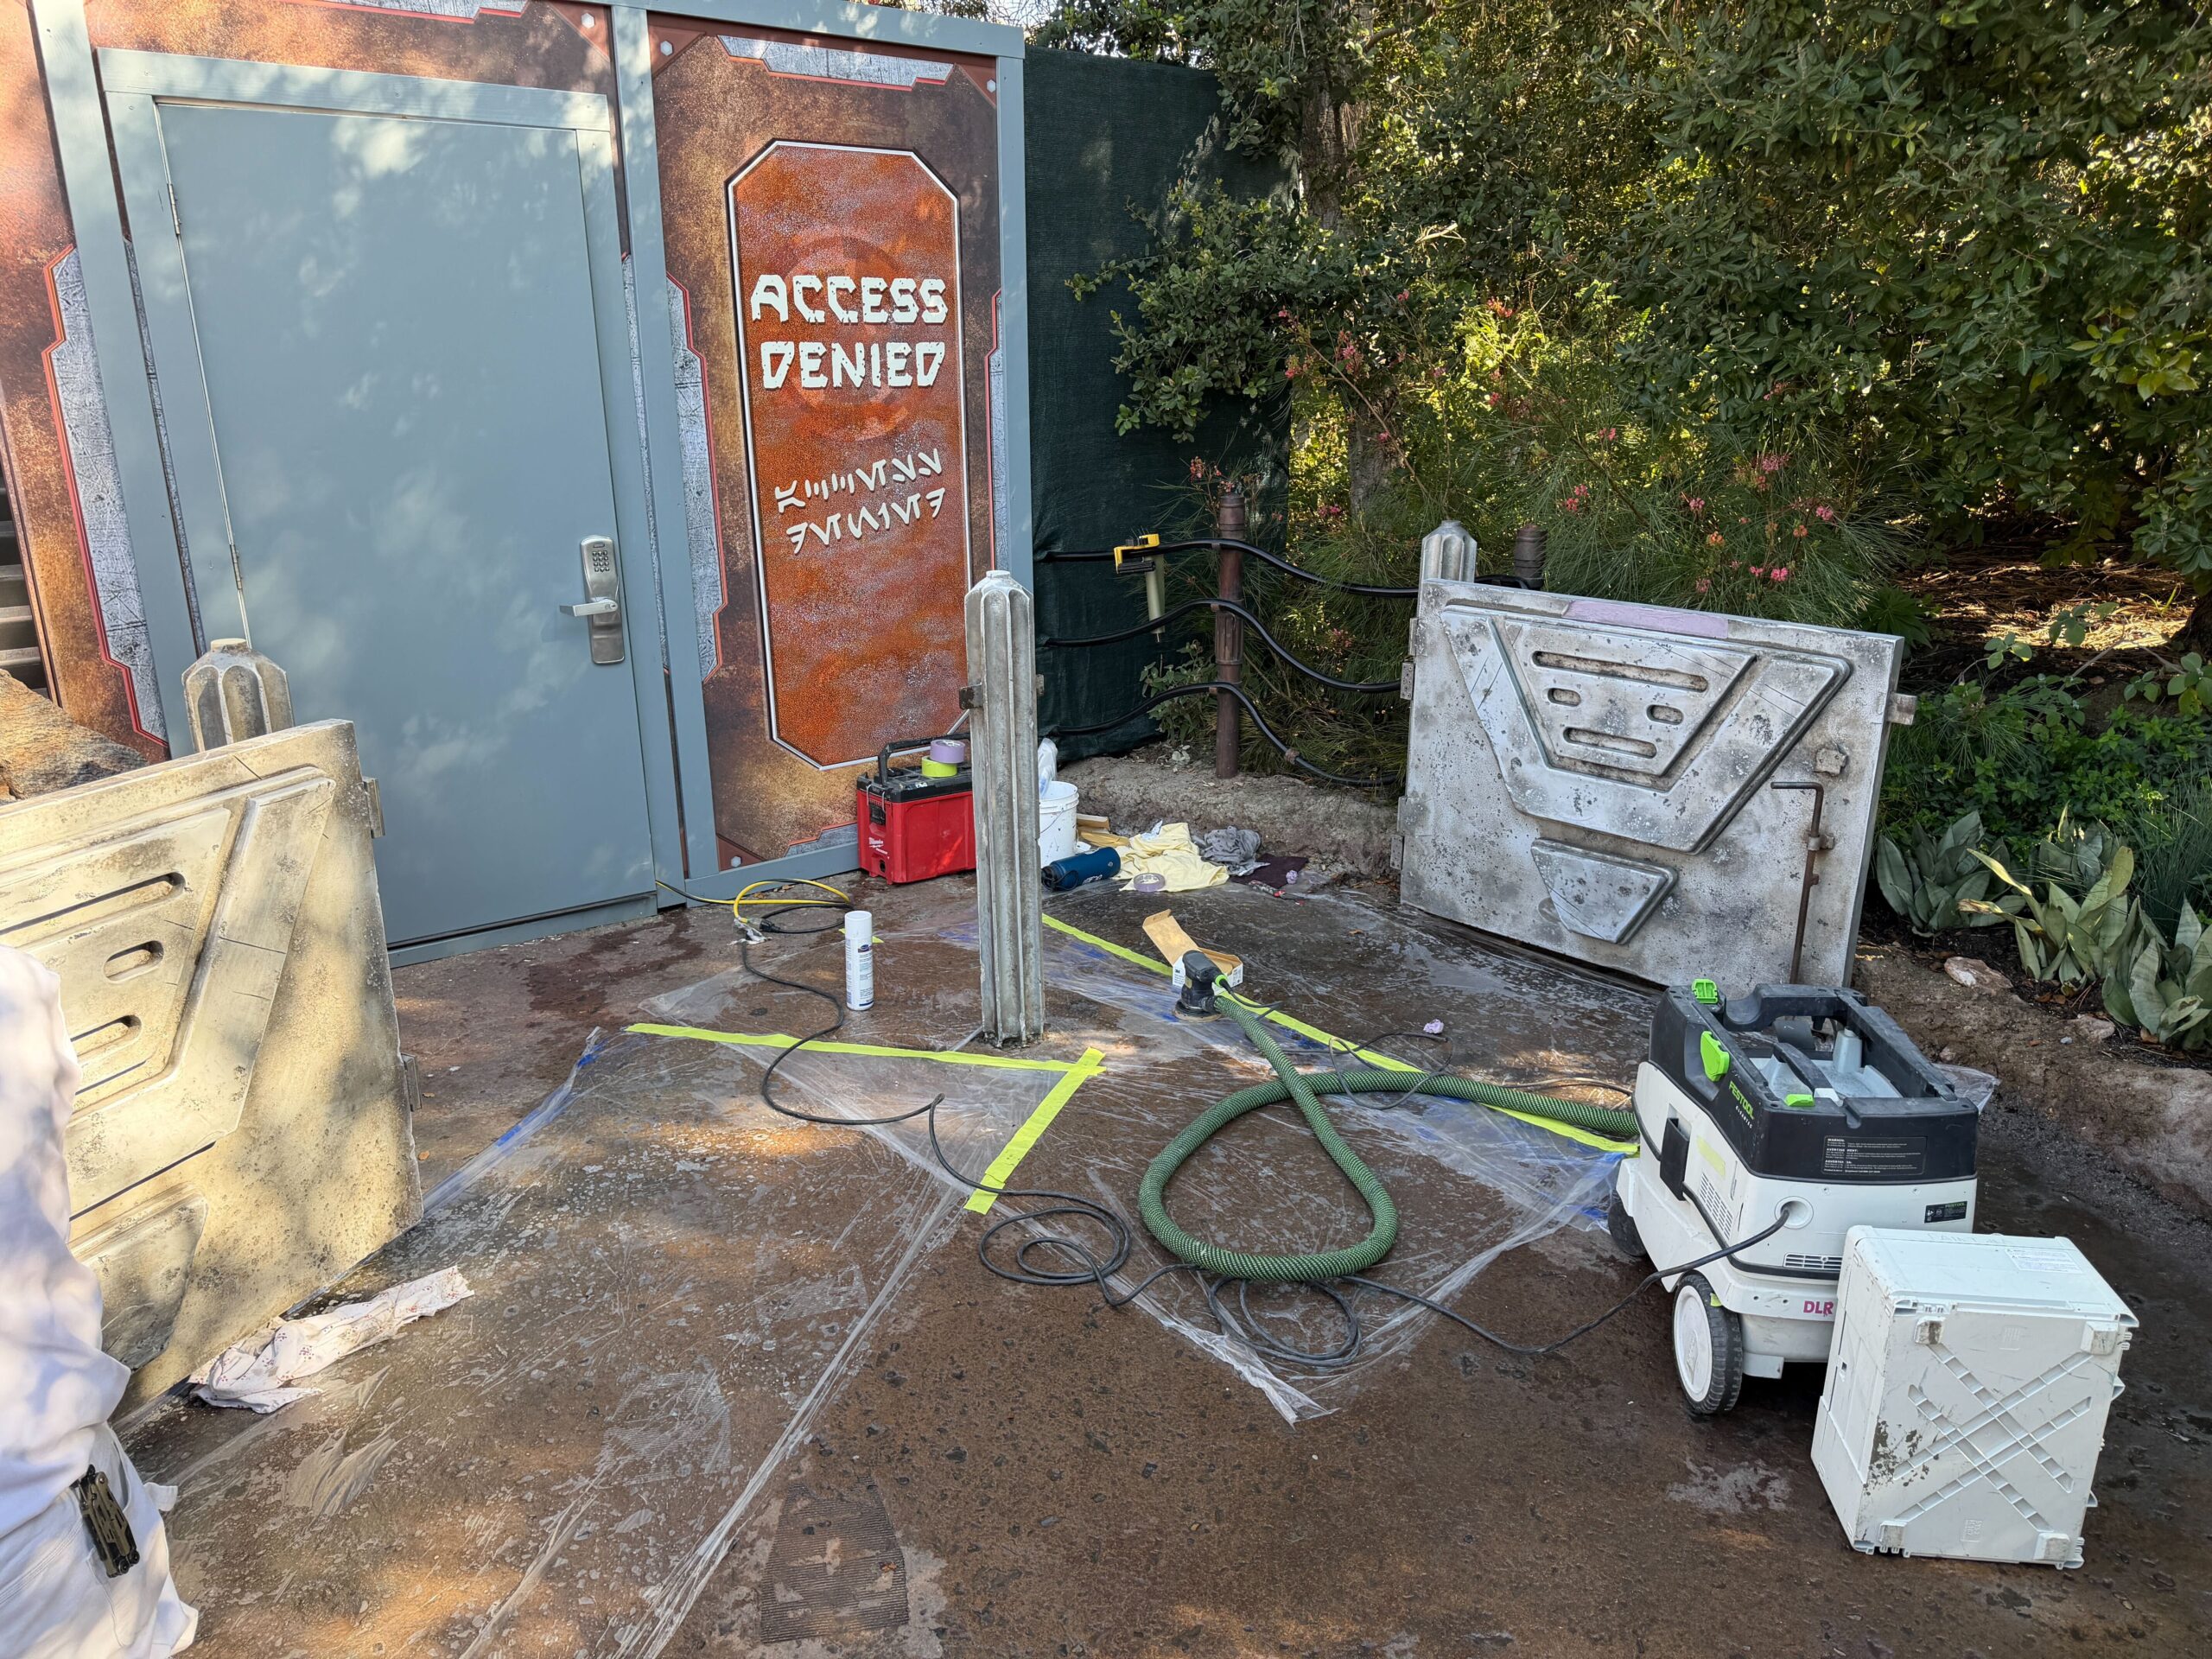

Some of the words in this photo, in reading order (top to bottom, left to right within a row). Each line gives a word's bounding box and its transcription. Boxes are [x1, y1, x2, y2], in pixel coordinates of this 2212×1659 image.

[750, 274, 949, 324] ACCESS
[760, 340, 946, 389] DENIED
[1729, 1080, 1755, 1120] FESTOOL
[1803, 1300, 1834, 1315] DLR
